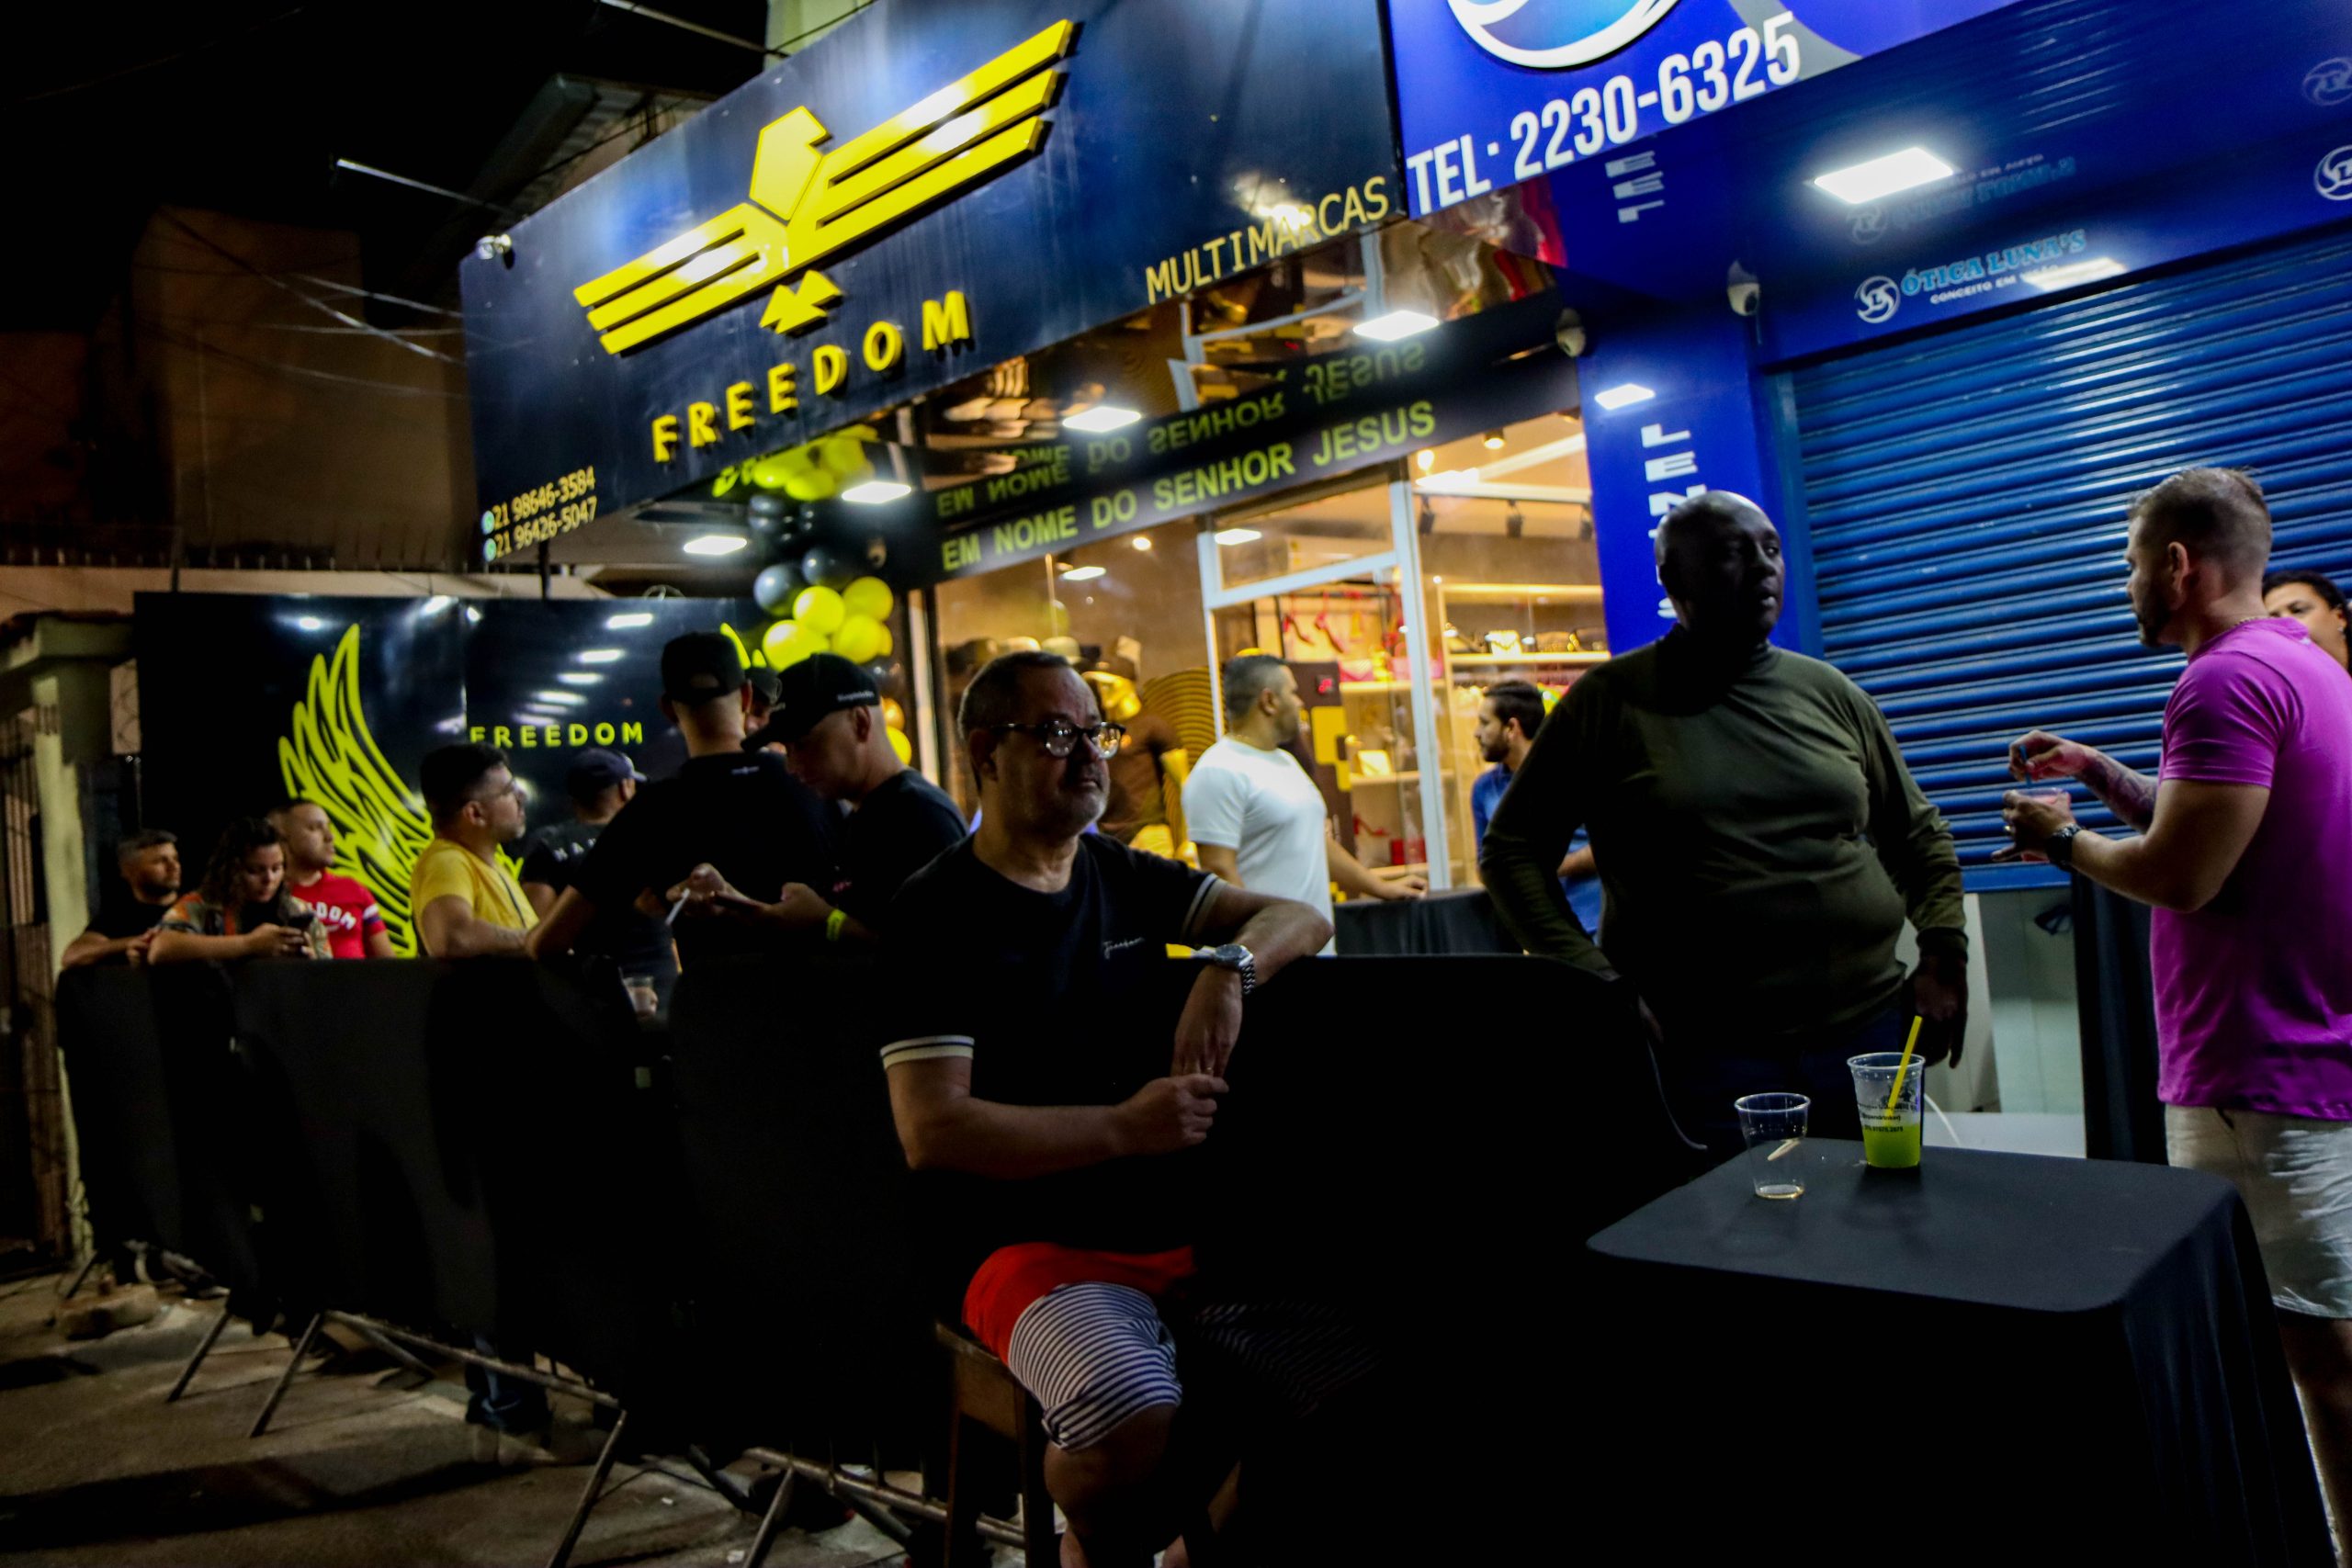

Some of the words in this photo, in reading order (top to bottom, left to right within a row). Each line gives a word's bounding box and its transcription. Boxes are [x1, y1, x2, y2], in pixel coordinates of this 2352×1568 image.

[1510, 10, 1802, 182] 2230-6325
[1145, 175, 1390, 306] MULTIMARCAS
[1900, 266, 1986, 297] ÓTICA
[1985, 228, 2087, 275] LUNA'S
[651, 289, 971, 463] FREEDOM
[492, 501, 511, 531] 21
[511, 464, 596, 523] 98646-3584
[494, 529, 513, 558] 21
[513, 494, 598, 551] 96426-5047
[940, 532, 982, 571] EM
[993, 505, 1079, 557] NOME
[1091, 489, 1137, 530] DO
[1152, 441, 1296, 512] SENHOR
[1312, 400, 1436, 467] JESUS
[469, 720, 644, 750] FREEDOM
